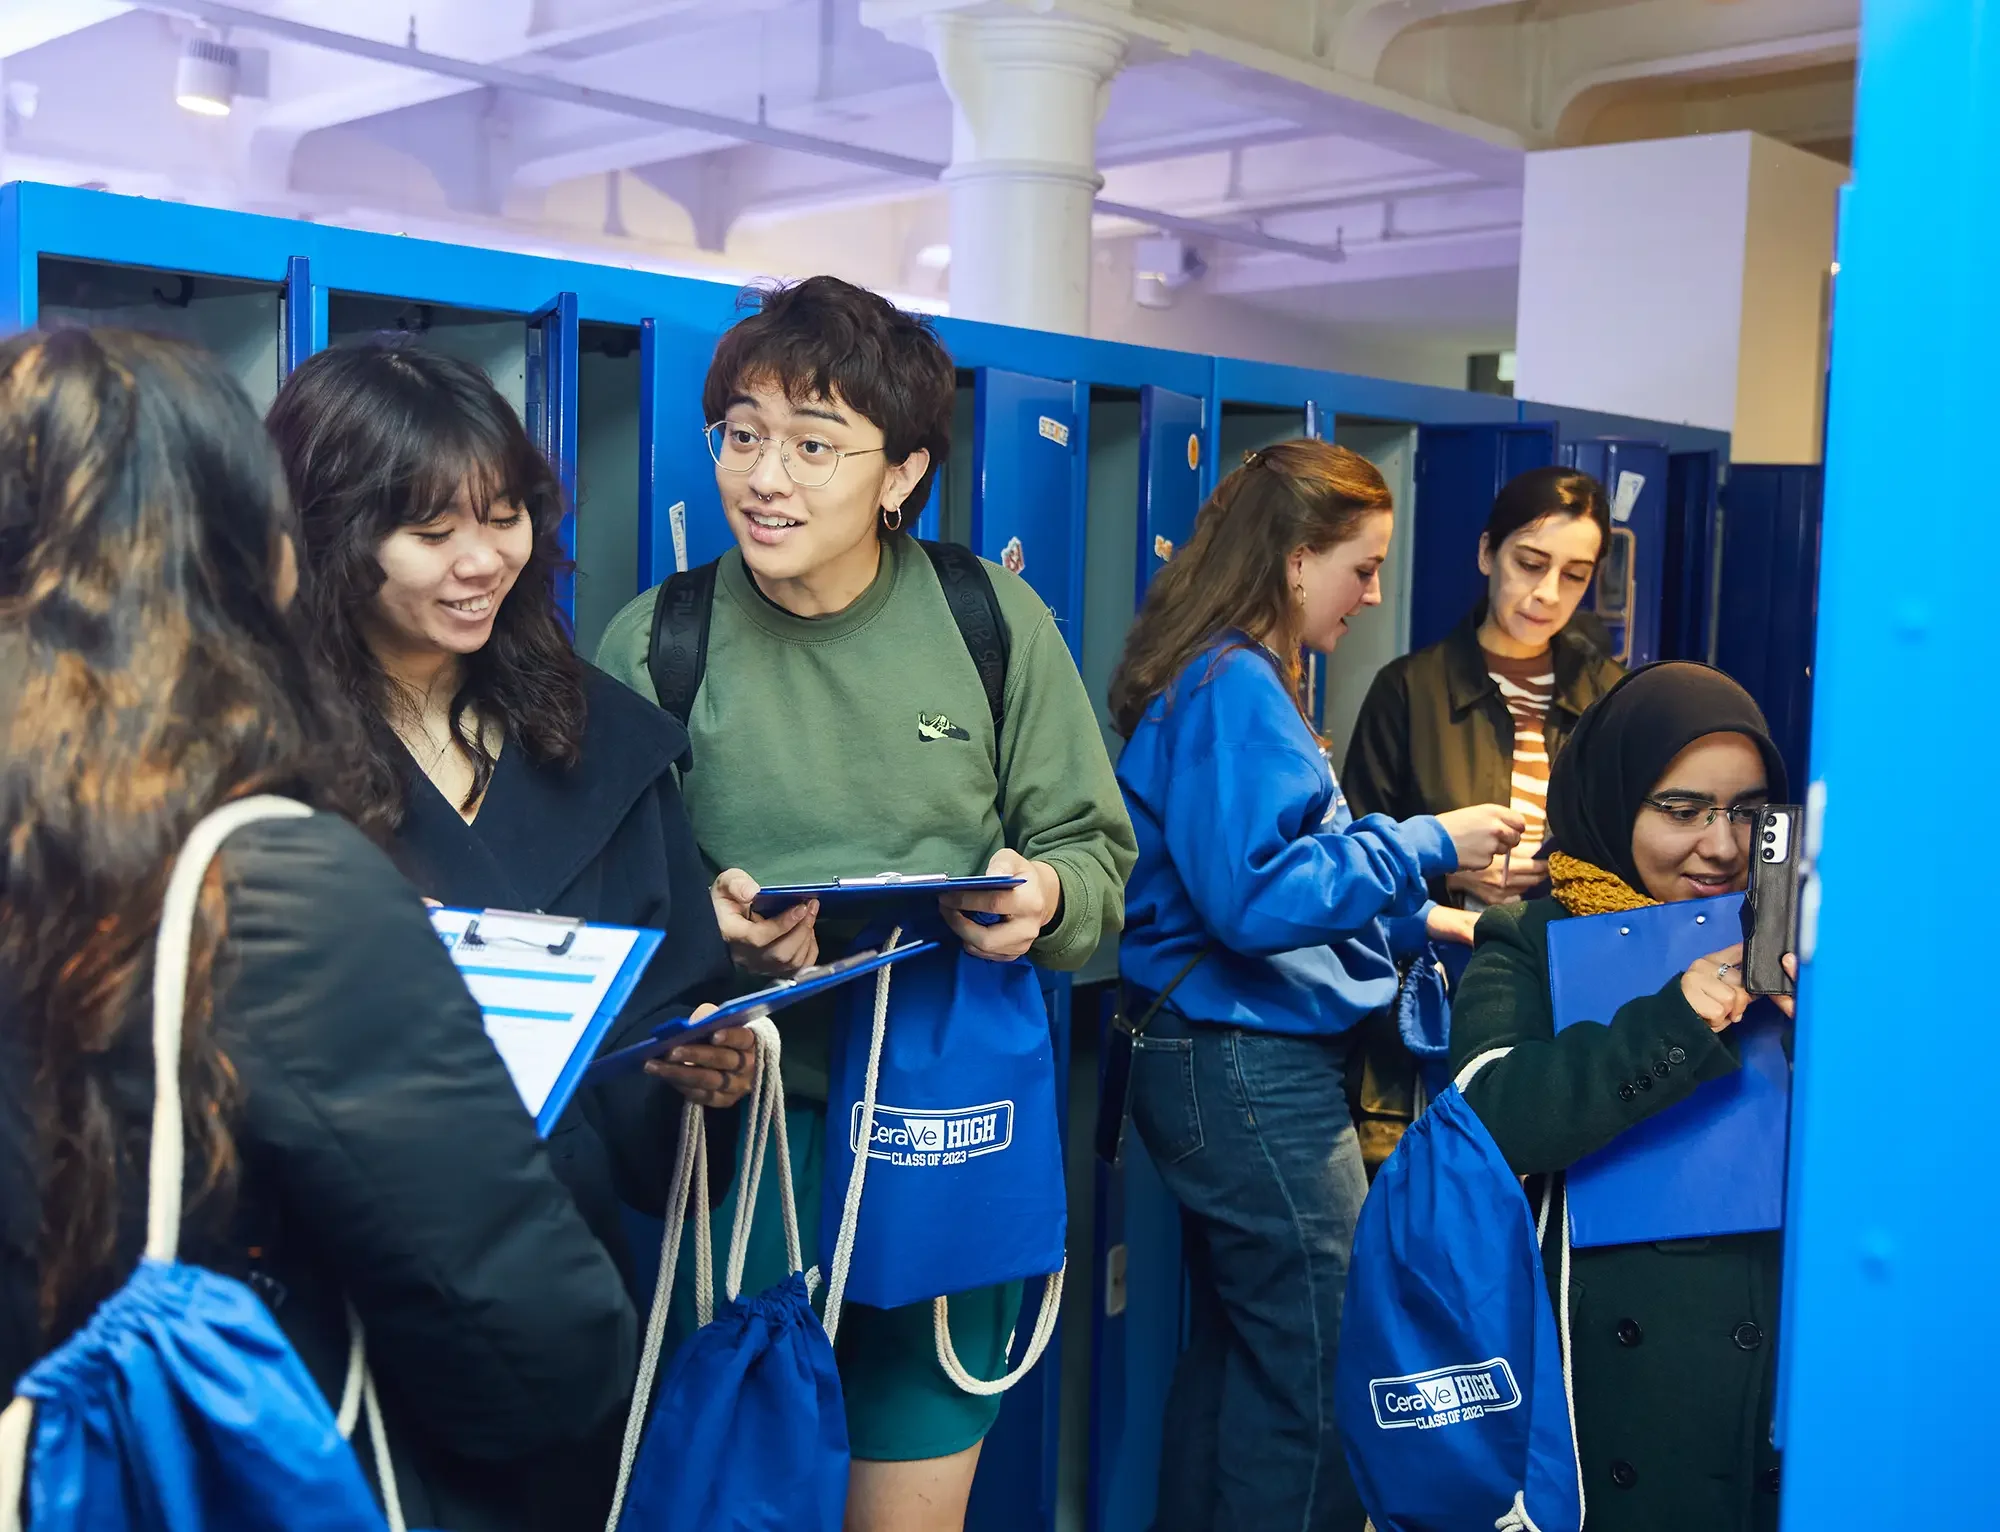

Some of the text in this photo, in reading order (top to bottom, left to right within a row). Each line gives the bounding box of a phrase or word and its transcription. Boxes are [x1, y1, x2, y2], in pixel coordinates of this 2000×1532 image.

[869, 1114, 997, 1148] CeraVe HIGH
[891, 1150, 967, 1167] CLASS OF 2023
[1385, 1373, 1500, 1413] CeraVe HIGH
[1415, 1405, 1485, 1430] CLASS OF 2023
